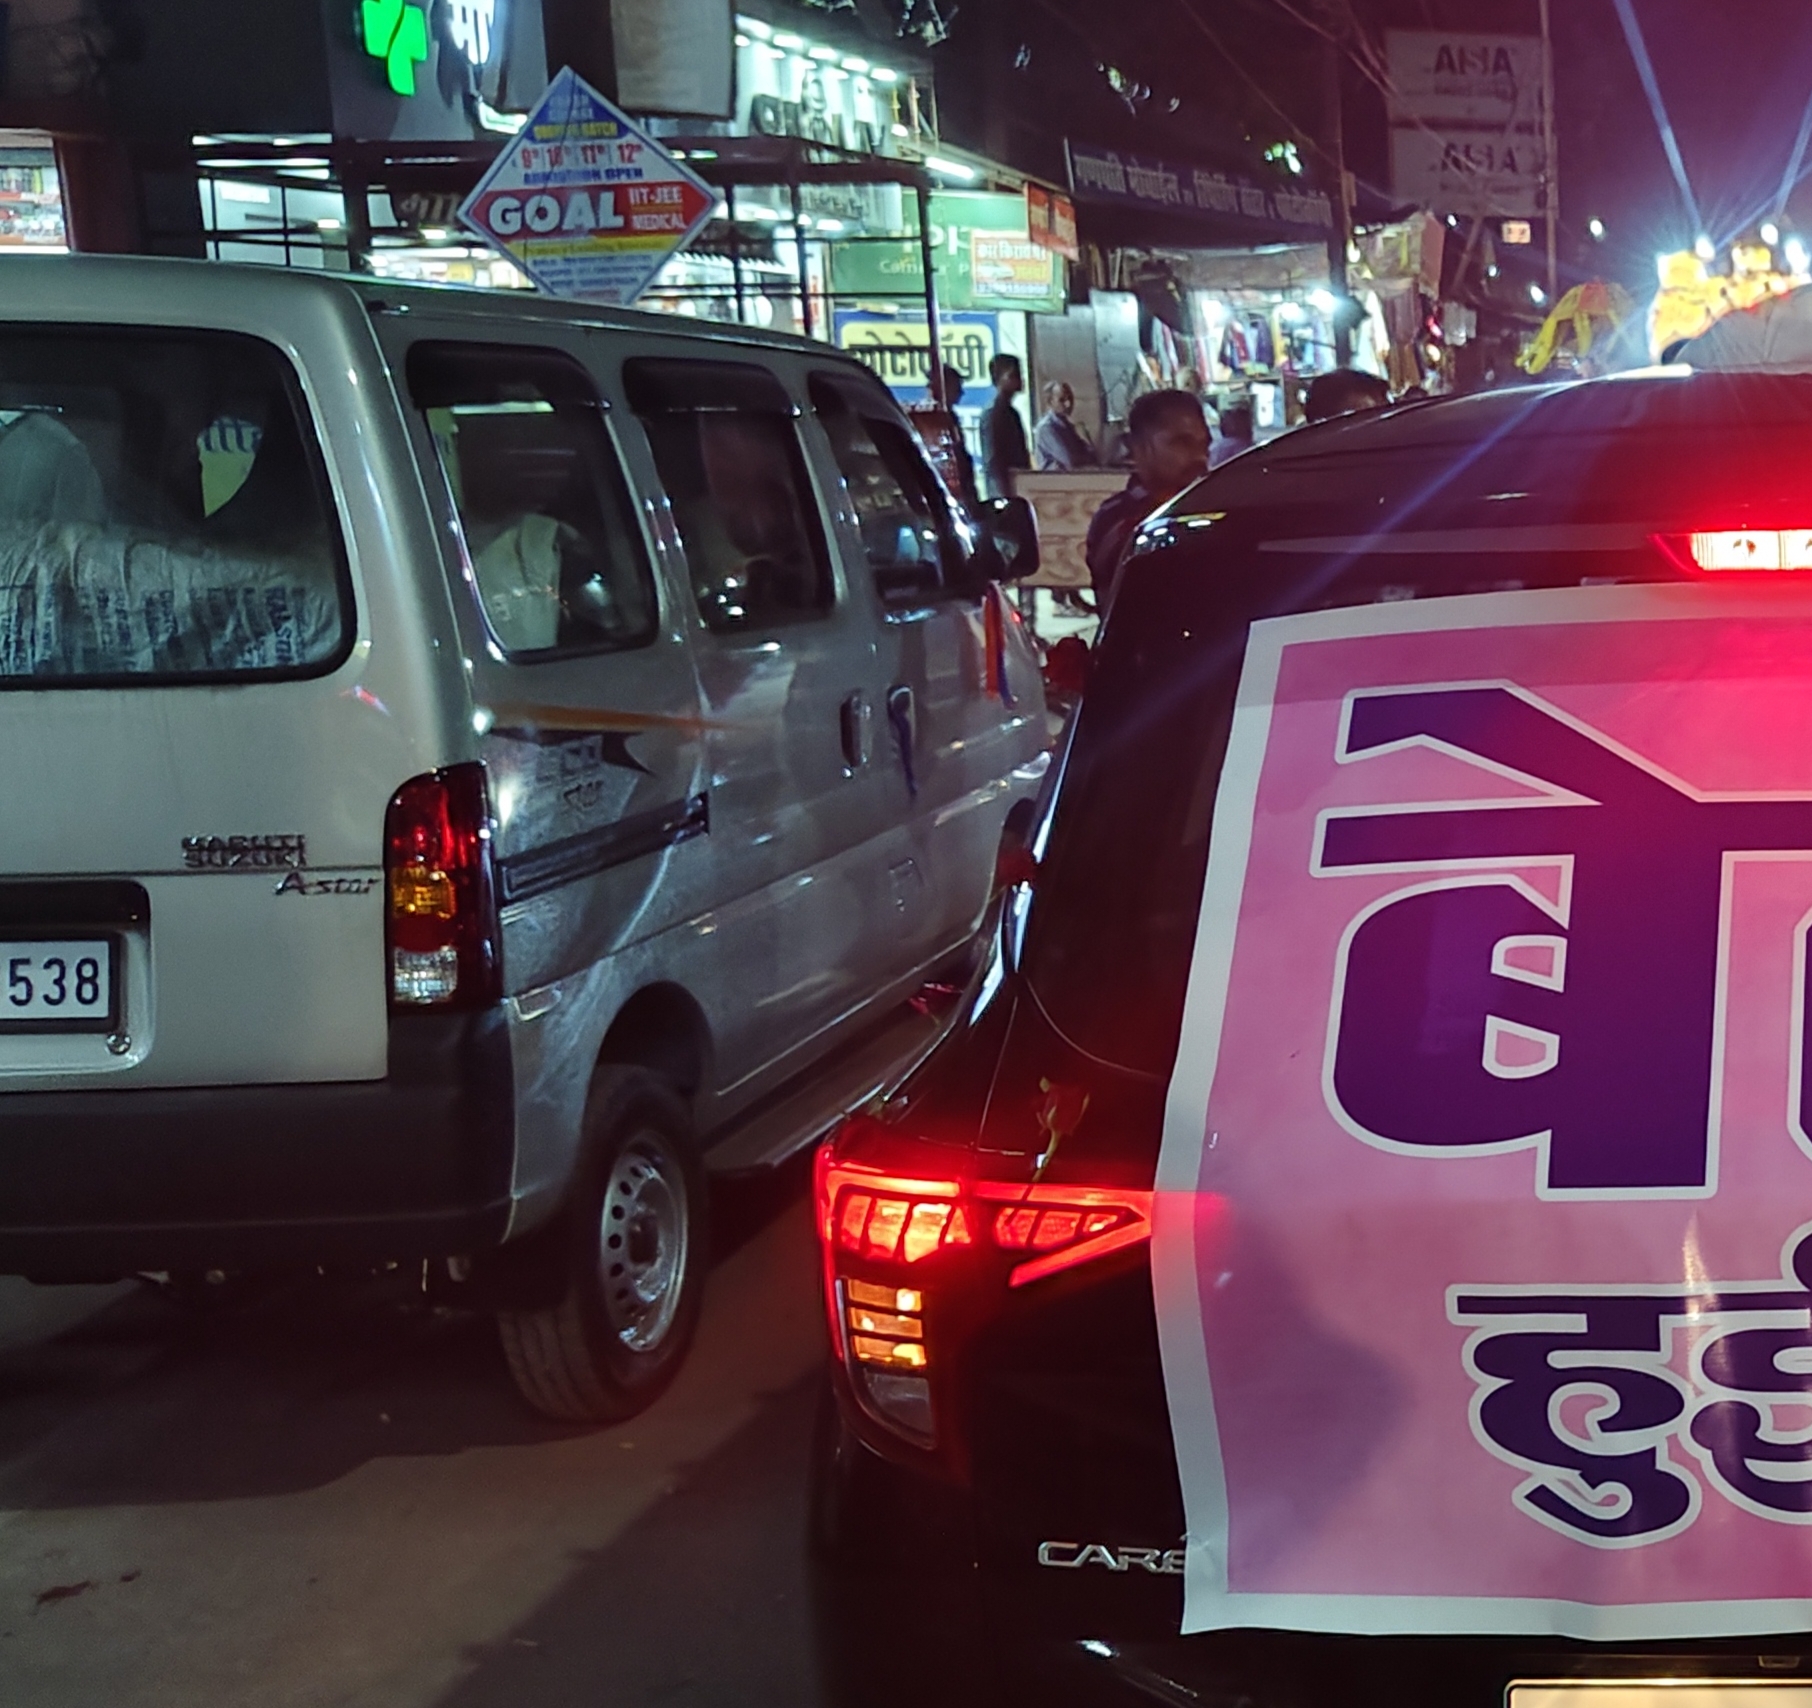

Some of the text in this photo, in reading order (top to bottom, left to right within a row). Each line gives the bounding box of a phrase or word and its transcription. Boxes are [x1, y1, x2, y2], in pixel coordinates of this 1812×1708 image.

[628, 187, 682, 205] IIT-JEE
[489, 191, 624, 235] GOAL
[631, 213, 688, 231] MEDICAL
[183, 848, 307, 868] SUZUKI
[8, 957, 100, 1006] 538
